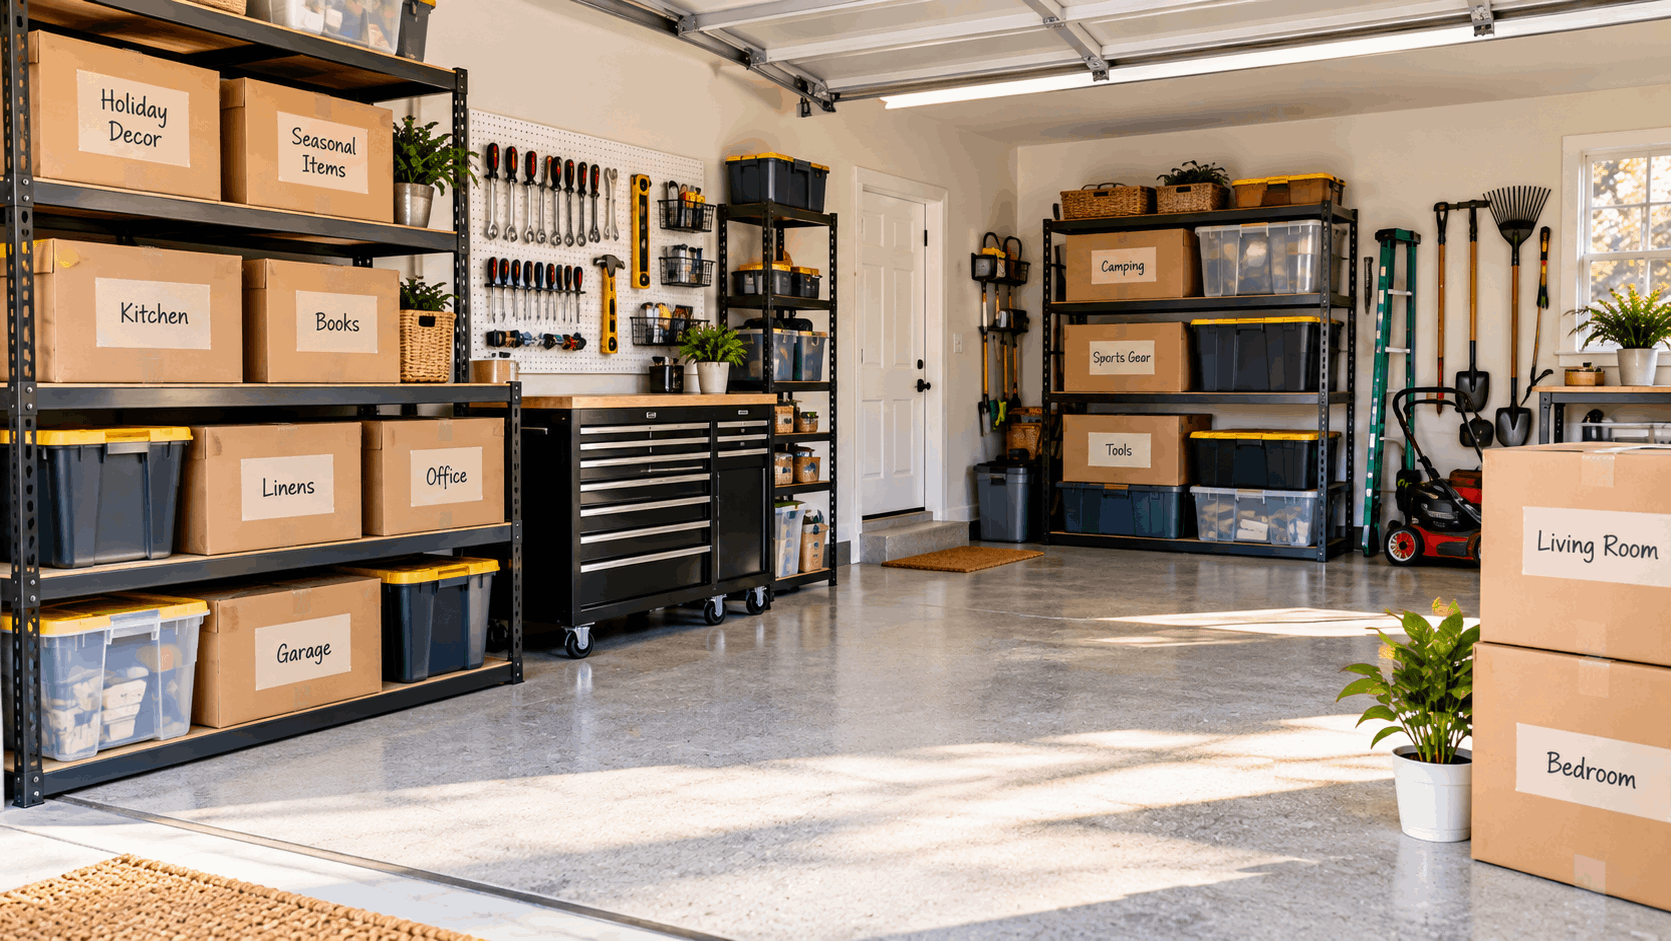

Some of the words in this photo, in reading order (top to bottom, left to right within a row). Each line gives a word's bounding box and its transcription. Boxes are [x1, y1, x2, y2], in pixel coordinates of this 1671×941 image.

[101, 88, 168, 129] Holiday
[108, 120, 163, 148] Decor
[291, 126, 357, 155] Seasonal
[302, 154, 346, 178] Items
[1101, 260, 1145, 276] Camping
[121, 301, 189, 325] Kitchen
[315, 311, 360, 332] Books
[1092, 351, 1126, 366] Sports
[1128, 350, 1151, 363] Gear
[1105, 443, 1133, 457] Tools
[262, 477, 315, 498] Linens
[426, 465, 468, 490] Office
[1537, 529, 1595, 564] Living
[1603, 534, 1659, 560] Room
[276, 643, 332, 665] Garage
[1546, 751, 1636, 790] Bedroom
